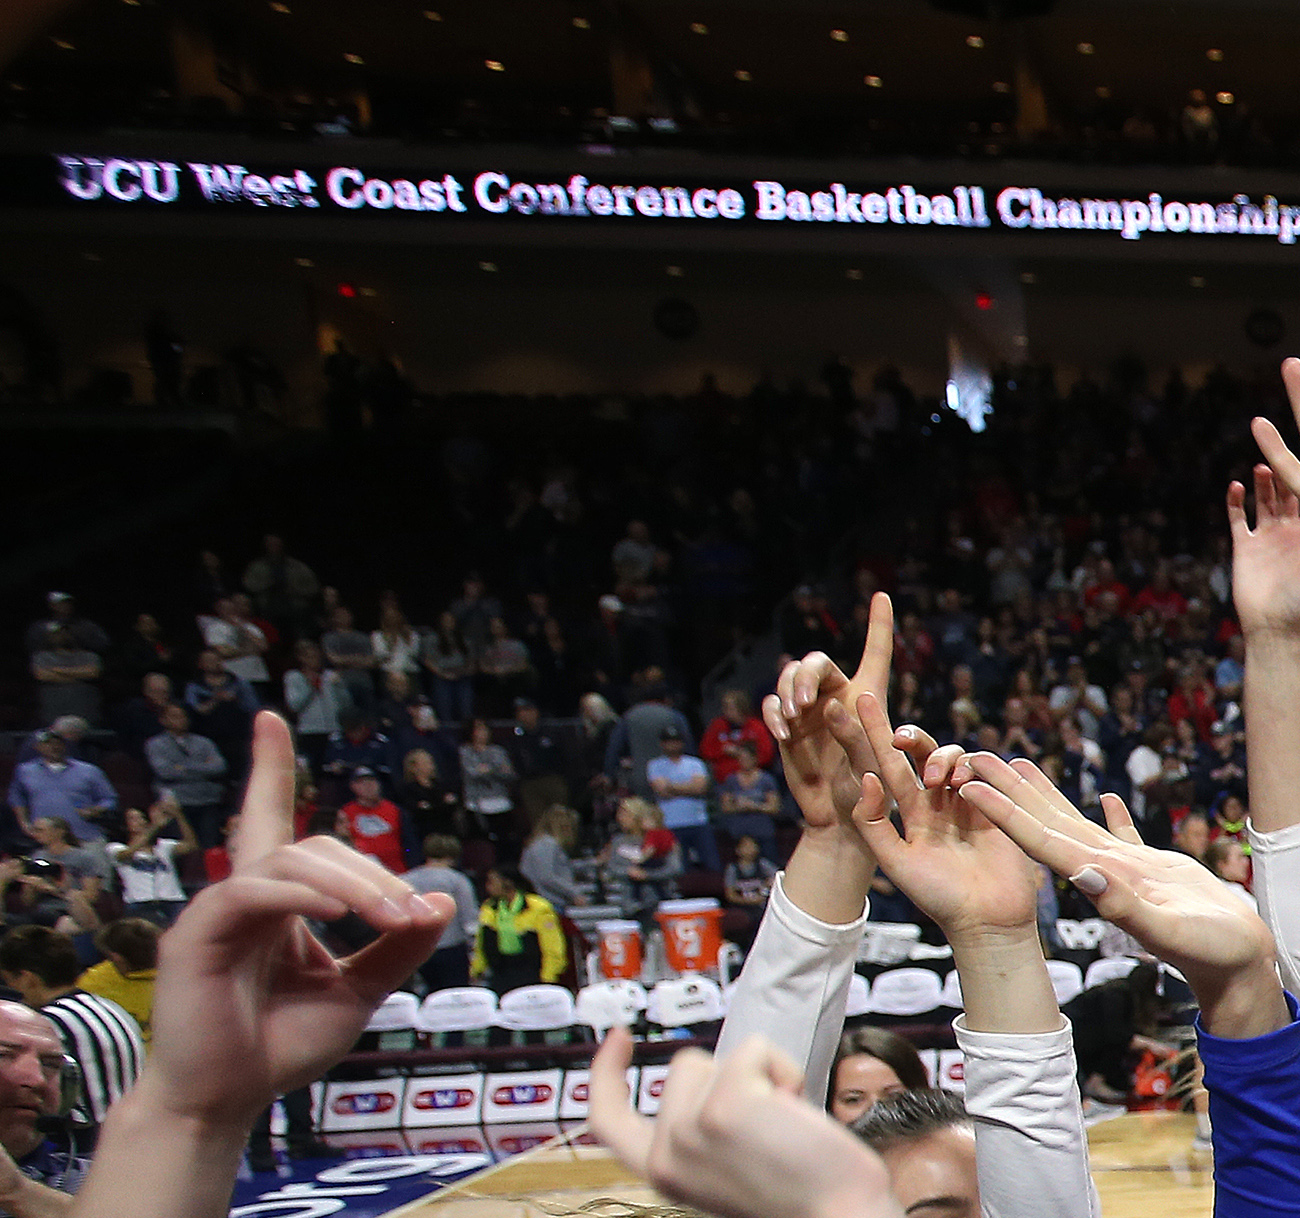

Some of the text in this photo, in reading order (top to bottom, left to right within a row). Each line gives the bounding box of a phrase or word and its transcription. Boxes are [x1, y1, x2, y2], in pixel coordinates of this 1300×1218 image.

[57, 156, 181, 202] UCU
[187, 163, 319, 208] West
[326, 167, 467, 213] Coast
[474, 171, 746, 220] Conference
[752, 180, 991, 228] Basketball
